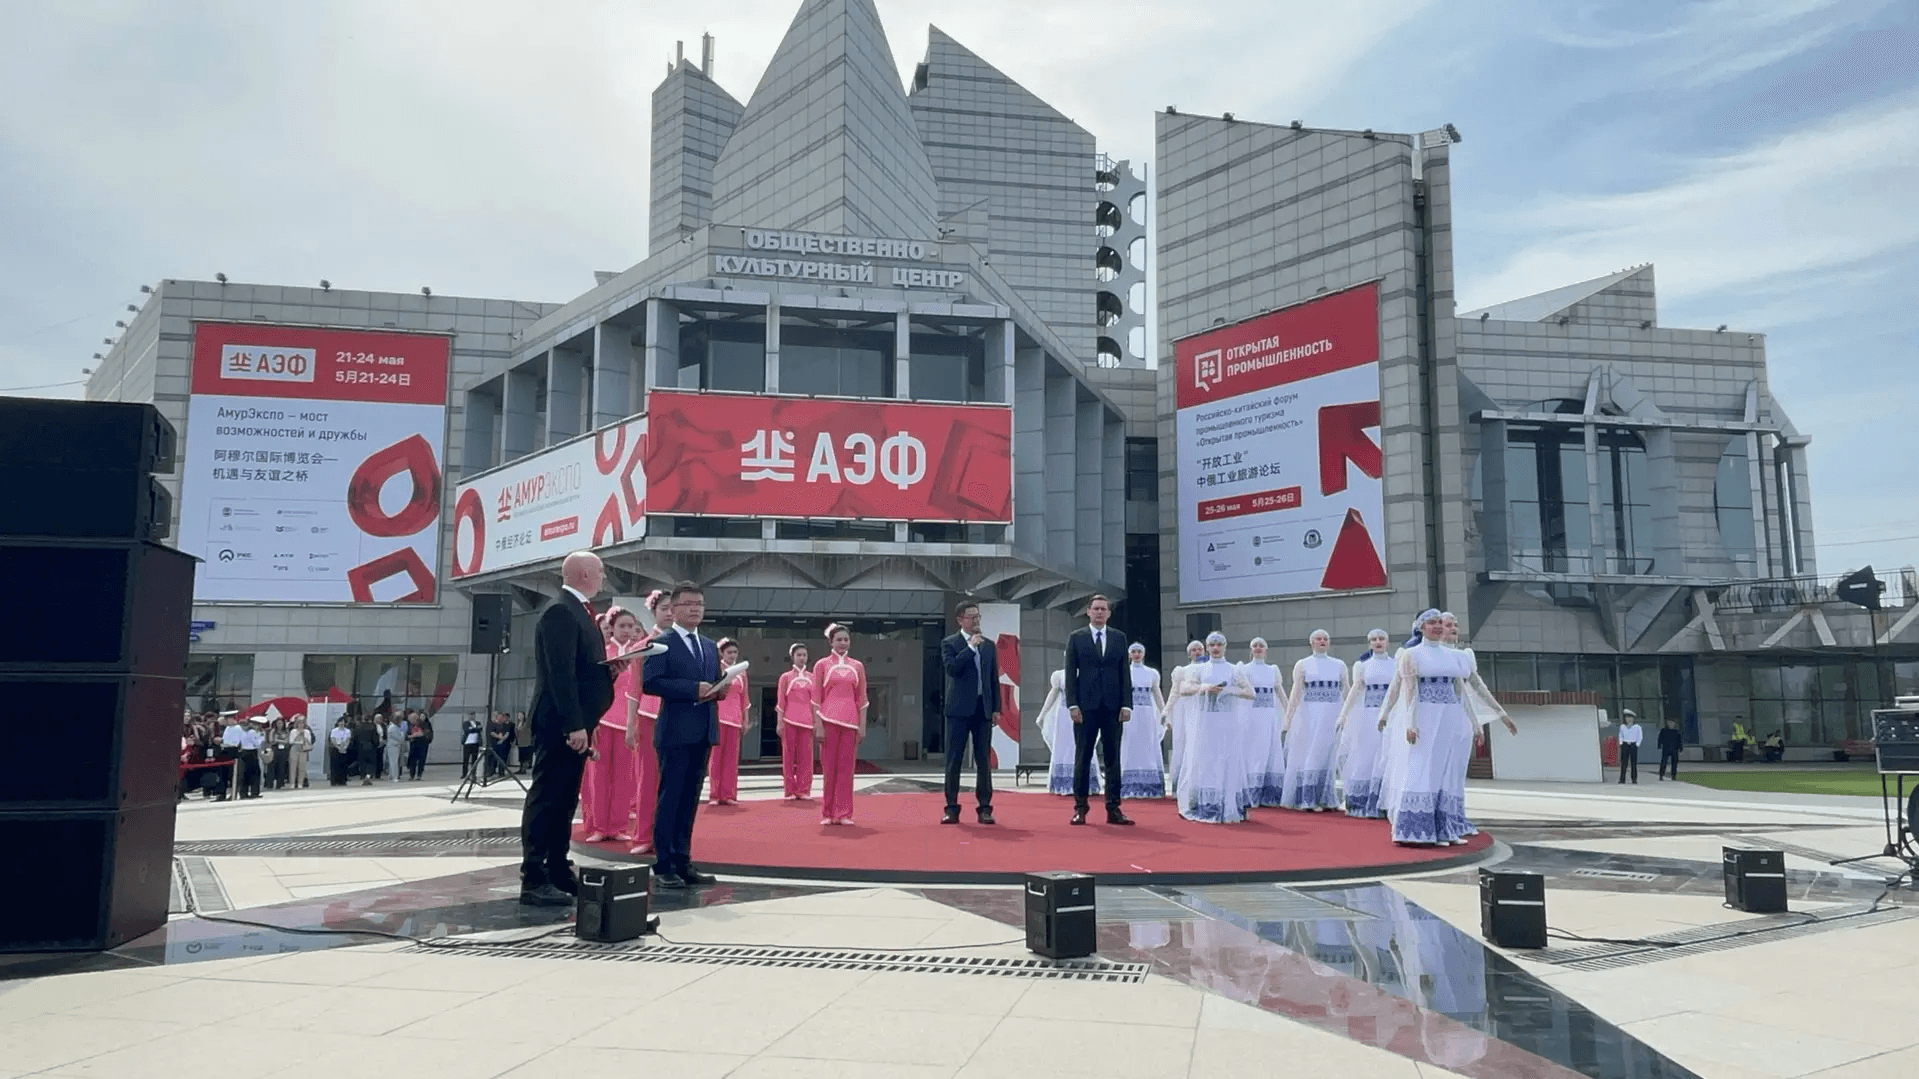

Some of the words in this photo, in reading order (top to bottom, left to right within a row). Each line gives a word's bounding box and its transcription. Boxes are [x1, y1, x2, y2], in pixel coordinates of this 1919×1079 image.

[715, 254, 874, 283] КУЛЬТУРНЫЙ
[891, 266, 964, 289] ЦЕНТР
[1226, 336, 1279, 360] ОТКРЫТАЯ
[256, 353, 307, 376] АЭФ
[336, 351, 375, 364] 21-24
[378, 356, 405, 366] мая
[1227, 339, 1332, 376] ПРОМЫШЛЕННОСТЬ
[335, 370, 411, 387] 5月21-24日
[1273, 392, 1299, 406] форум
[217, 406, 284, 421] АмурЭкспо
[300, 412, 329, 422] мост
[216, 426, 305, 439] возможностей
[308, 431, 316, 439] и
[318, 430, 367, 442] дружбы
[806, 431, 927, 490] АЭФ
[212, 467, 309, 483] 机遇与友谊之桥
[1196, 462, 1281, 488] 中俄工业旅游论坛
[1252, 492, 1295, 508] 5月25-26日
